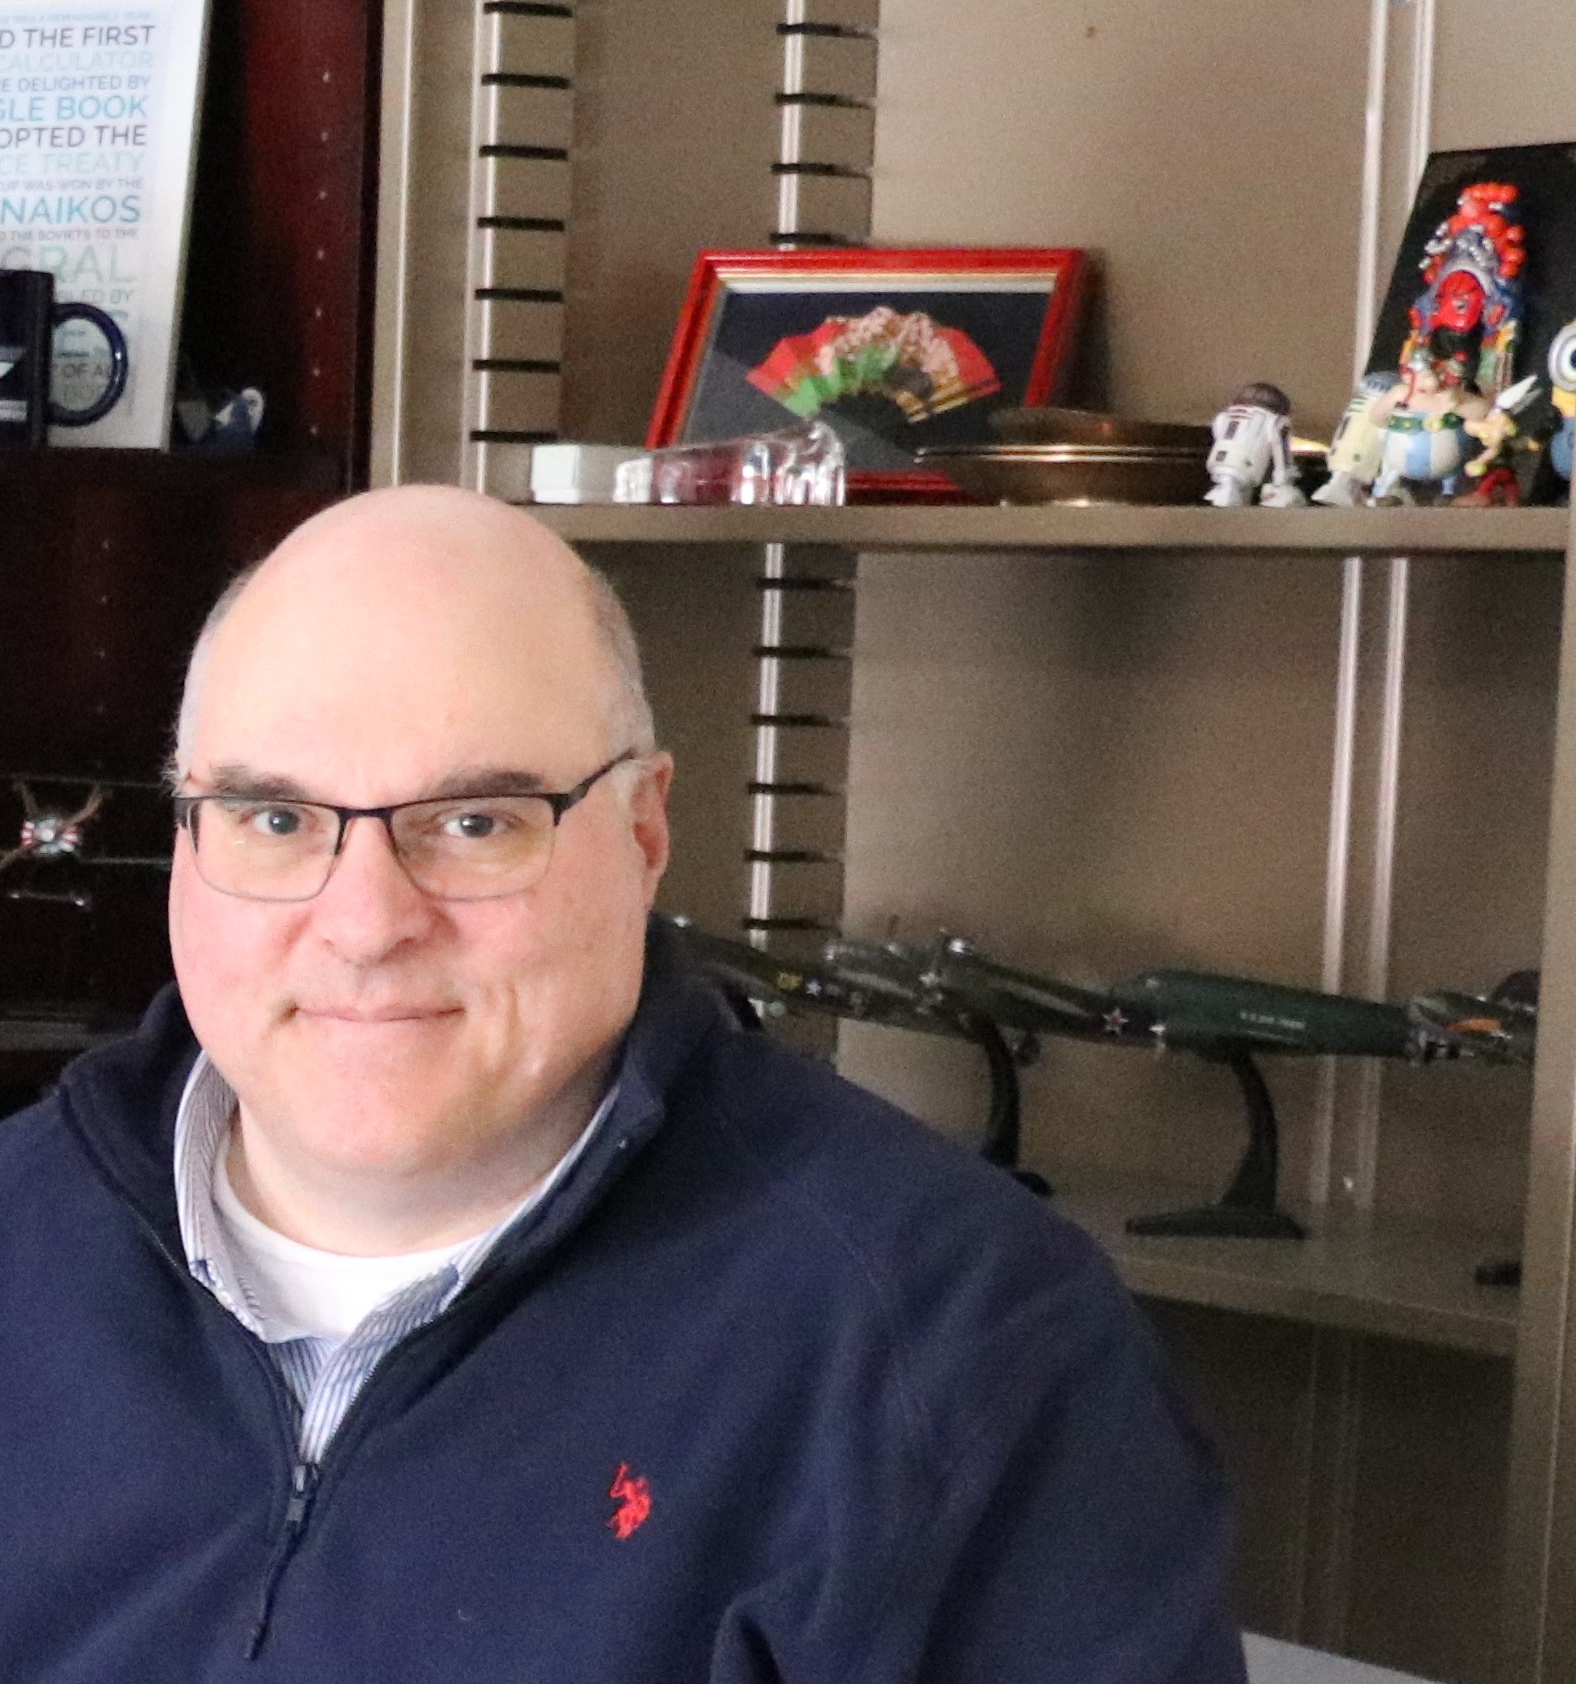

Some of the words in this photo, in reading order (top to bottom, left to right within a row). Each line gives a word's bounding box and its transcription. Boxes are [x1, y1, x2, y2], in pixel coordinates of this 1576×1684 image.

[22, 28, 74, 50] THE
[82, 25, 156, 47] FIRST
[17, 75, 122, 94] DELIGHTED
[126, 74, 150, 91] BY
[55, 95, 148, 121] BOOK
[94, 124, 148, 147] THE
[41, 151, 146, 175] TREATY
